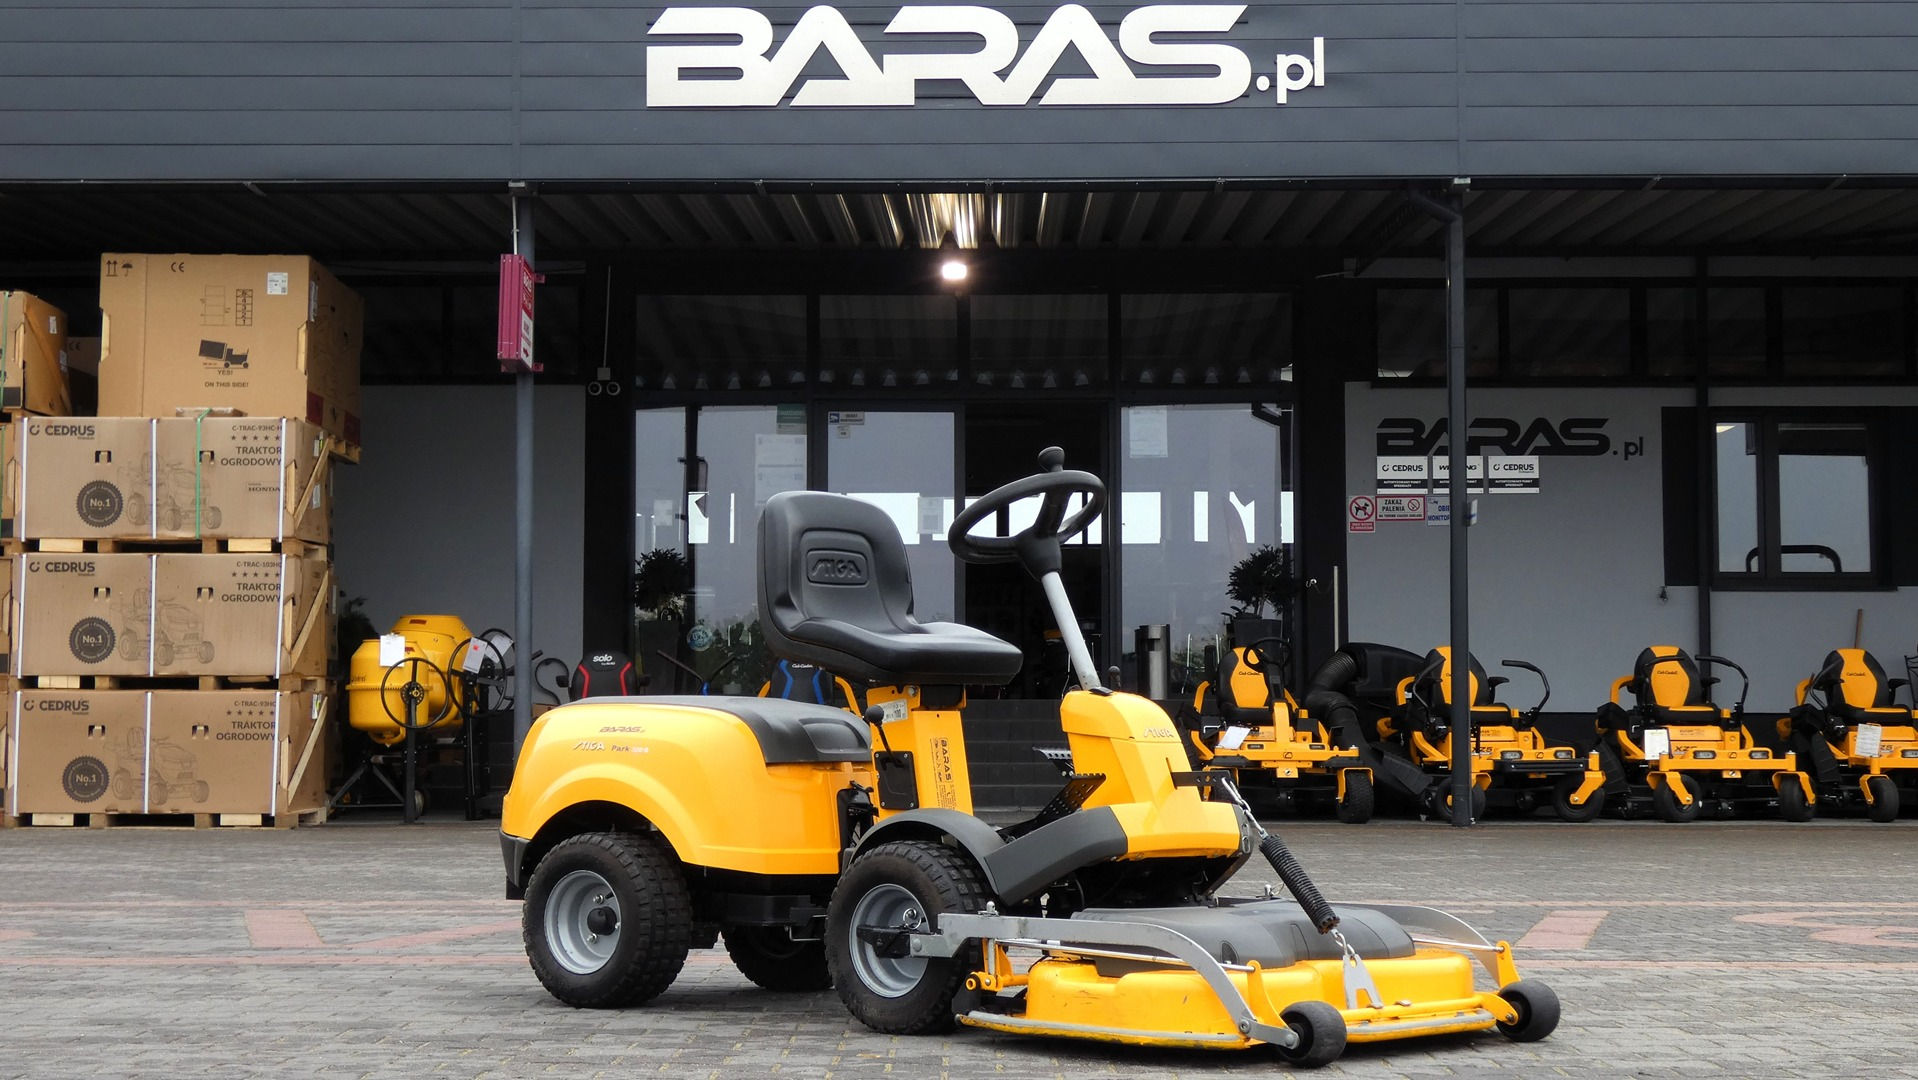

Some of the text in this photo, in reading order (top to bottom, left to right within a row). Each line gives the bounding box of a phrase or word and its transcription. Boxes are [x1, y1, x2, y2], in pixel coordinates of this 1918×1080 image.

[646, 3, 1325, 108] BARAS.pl
[45, 425, 96, 436] CEDRUS
[236, 446, 282, 455] TRAKTOR
[220, 458, 282, 466] OGRODOWY
[1392, 464, 1424, 472] CEDRUS
[1503, 463, 1535, 471] CEDRUS
[89, 498, 110, 507] No.1
[45, 562, 96, 573] CEDRUS
[811, 558, 861, 578] STIGA
[236, 582, 281, 591] TRAKTOR
[221, 594, 281, 603] OGRODOWY
[82, 634, 103, 643] No.1
[592, 653, 613, 662] solo
[39, 700, 90, 711] CEDRUS
[231, 721, 276, 730] TRAKTOR
[216, 732, 276, 741] OGRODOWY
[611, 744, 630, 752] Park
[75, 774, 97, 783] No.1
